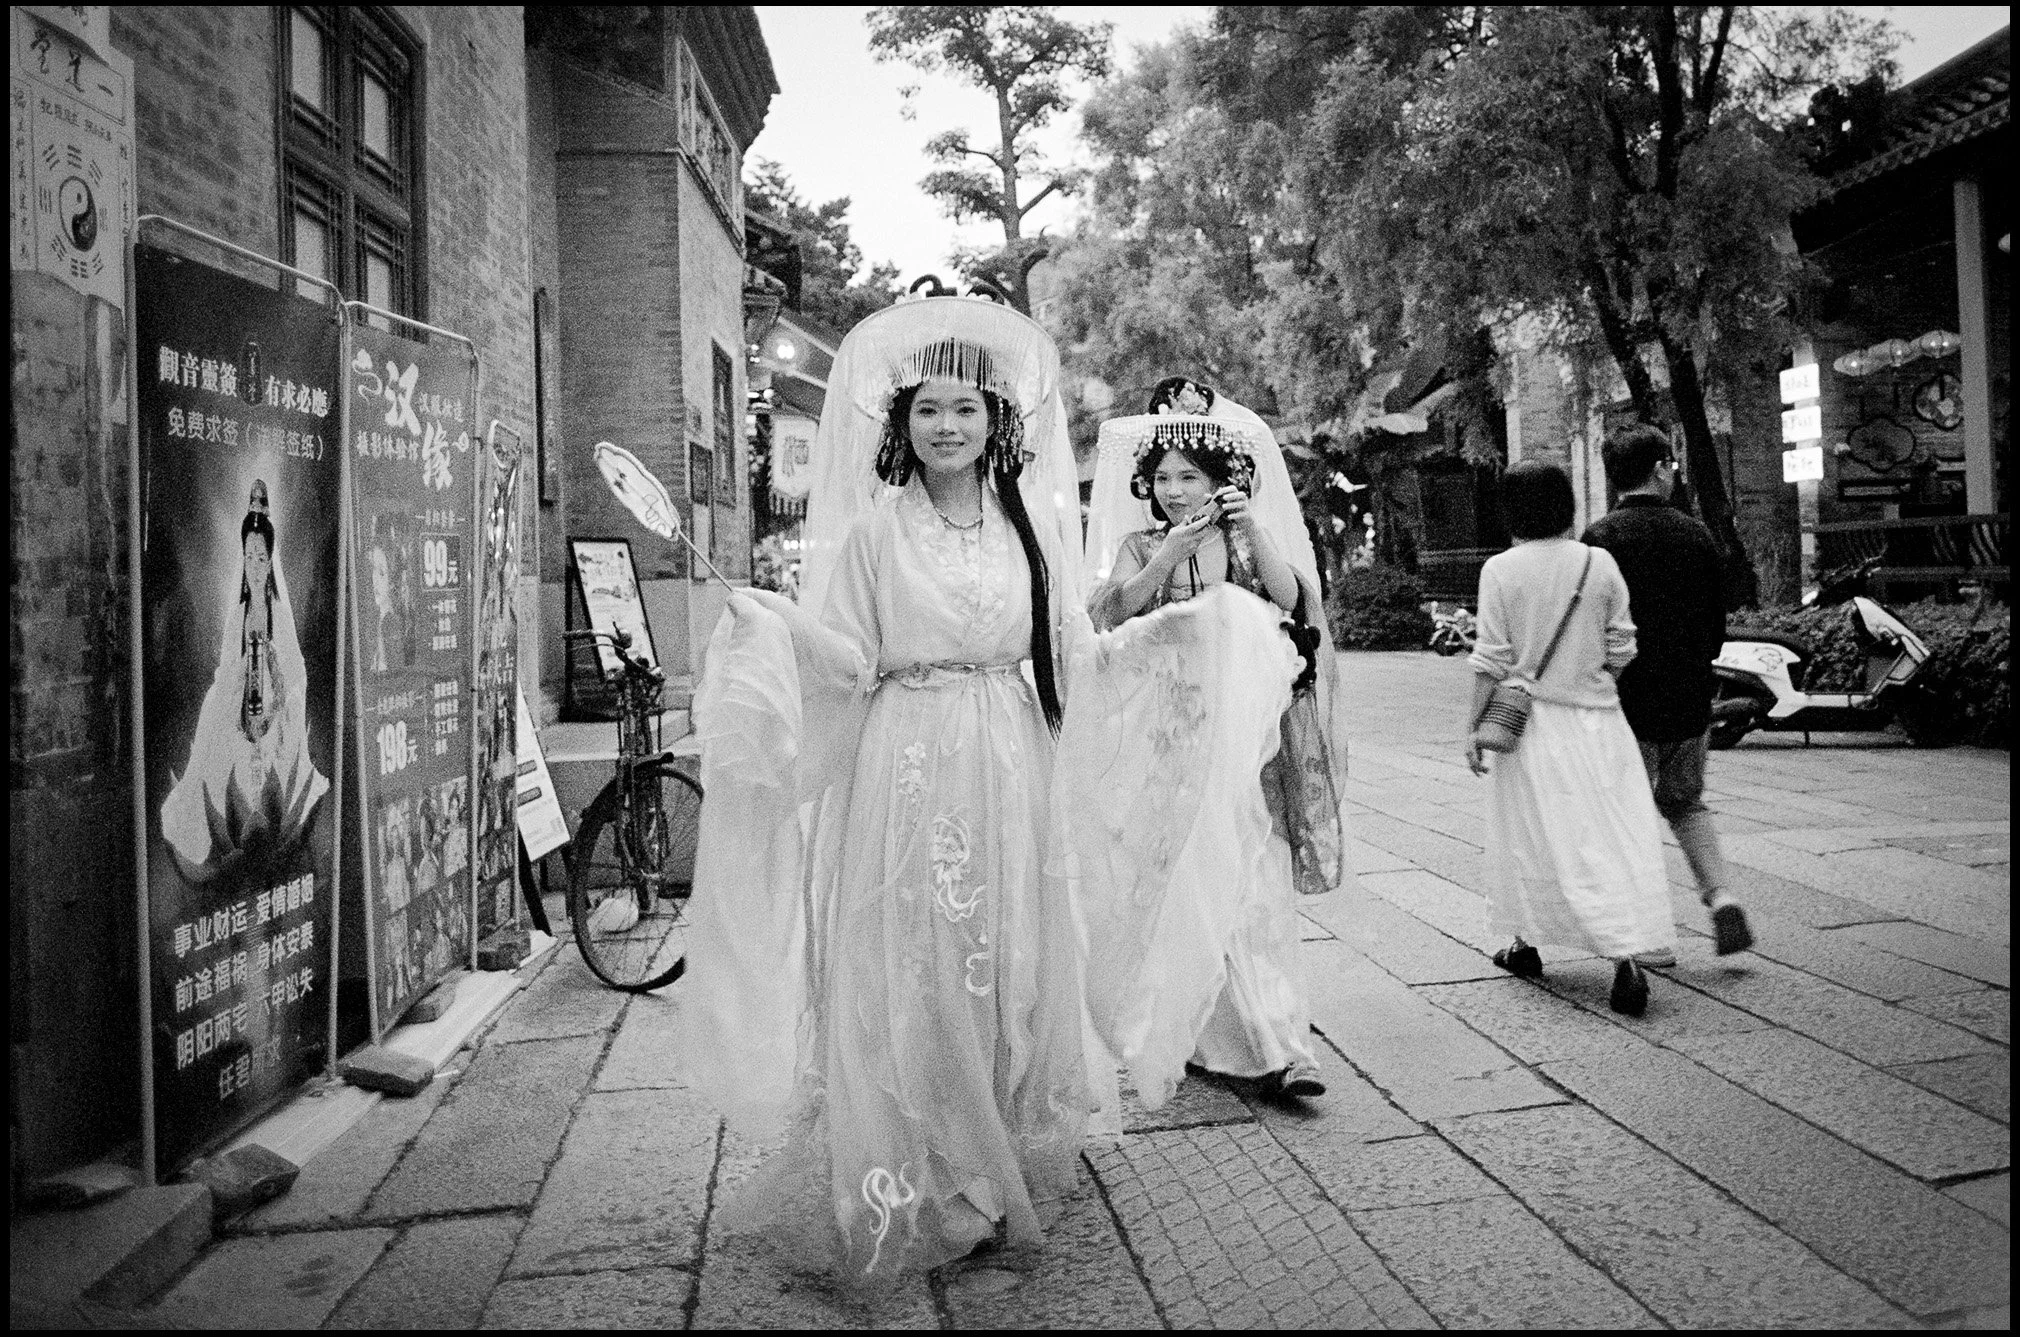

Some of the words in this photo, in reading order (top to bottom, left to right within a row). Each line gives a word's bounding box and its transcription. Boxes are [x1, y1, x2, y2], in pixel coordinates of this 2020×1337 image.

[265, 375, 328, 417] 有求必應
[168, 406, 238, 446] 免费求签
[424, 540, 458, 587] 99元
[377, 721, 418, 775] 198元
[174, 901, 247, 958] 事业财运
[256, 873, 313, 925] 爱情婚姻
[175, 951, 247, 1013] 前途福祸
[257, 920, 313, 970] 身体安泰
[177, 1000, 247, 1070] 阴阳两宅
